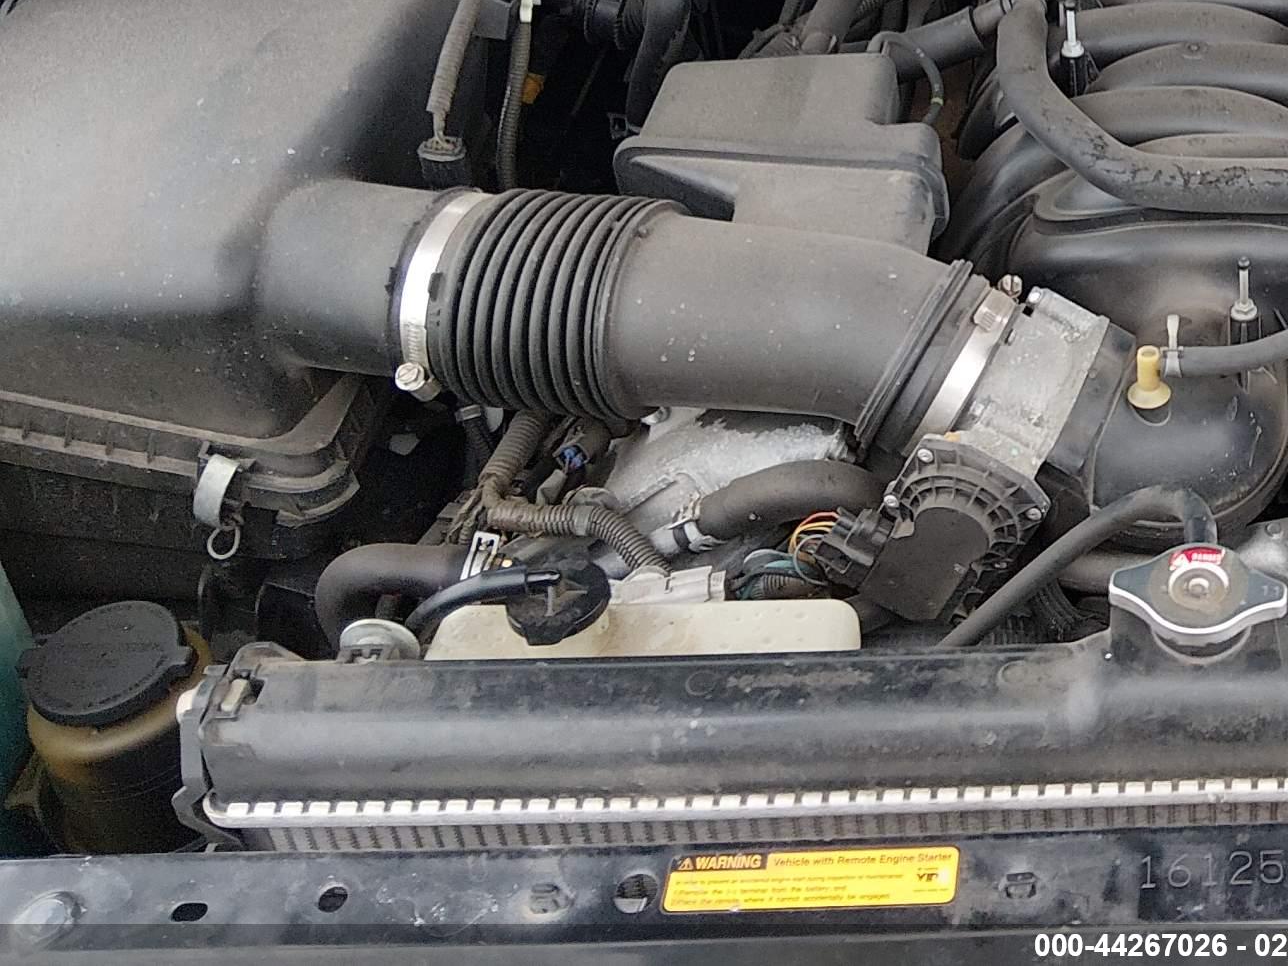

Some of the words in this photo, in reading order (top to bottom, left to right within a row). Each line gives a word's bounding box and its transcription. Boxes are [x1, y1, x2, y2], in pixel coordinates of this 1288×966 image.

[696, 854, 762, 870] WARNING
[773, 857, 810, 867] Vehicle
[813, 856, 834, 866] with
[837, 855, 876, 865] Remote
[879, 854, 915, 865] Engine
[918, 852, 952, 863] Starter
[1141, 849, 1284, 889] 16125
